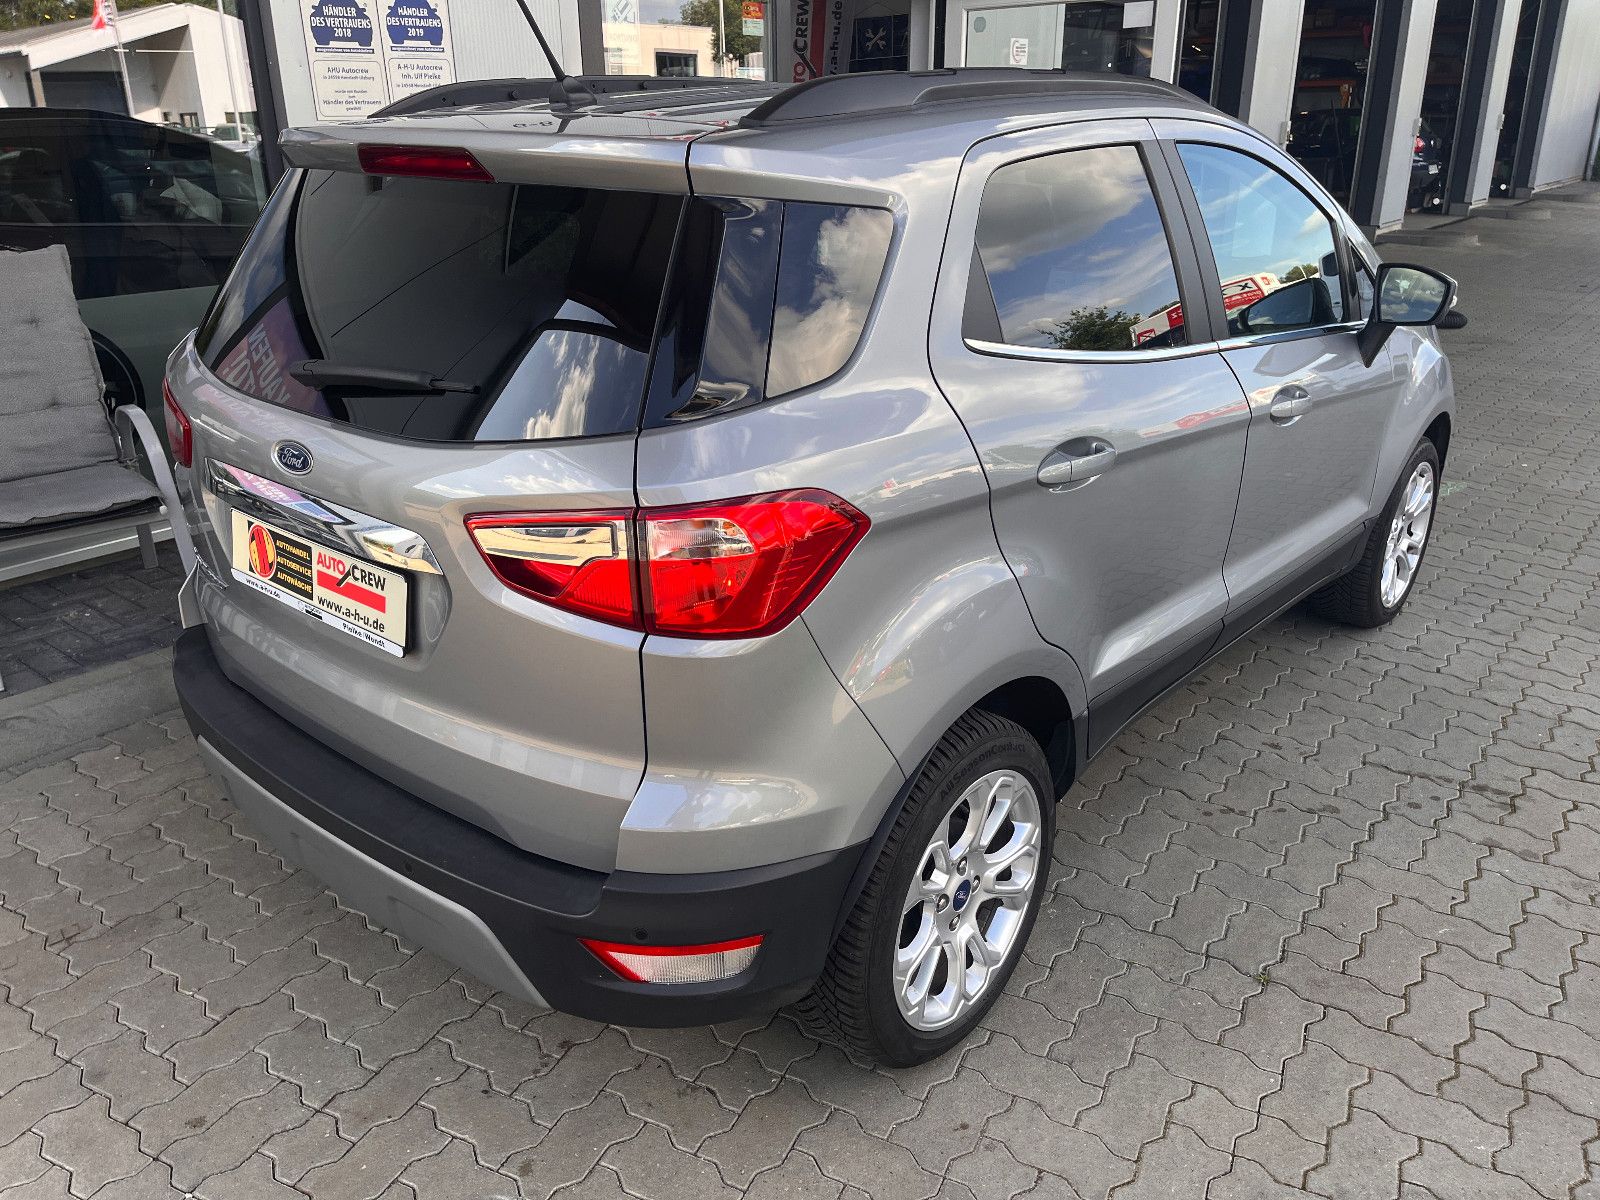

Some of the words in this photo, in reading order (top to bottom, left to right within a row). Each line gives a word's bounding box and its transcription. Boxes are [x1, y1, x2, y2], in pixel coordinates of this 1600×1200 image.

[322, 4, 357, 17] HÄNDLER
[397, 5, 429, 16] HÄNDLER
[310, 16, 325, 27] DES
[325, 17, 371, 29] VERTRAUENS
[386, 17, 400, 26] DES
[400, 17, 441, 28] VERTRAUENS
[333, 28, 352, 37] 2018
[407, 28, 424, 37] 2019
[281, 447, 304, 468] Ford
[276, 540, 311, 560] AUTOHANDEL
[276, 555, 312, 578] AUTOSERVICE
[316, 551, 346, 575] AUTO
[350, 563, 386, 591] CREW
[317, 595, 385, 633] www.a-h-u.de
